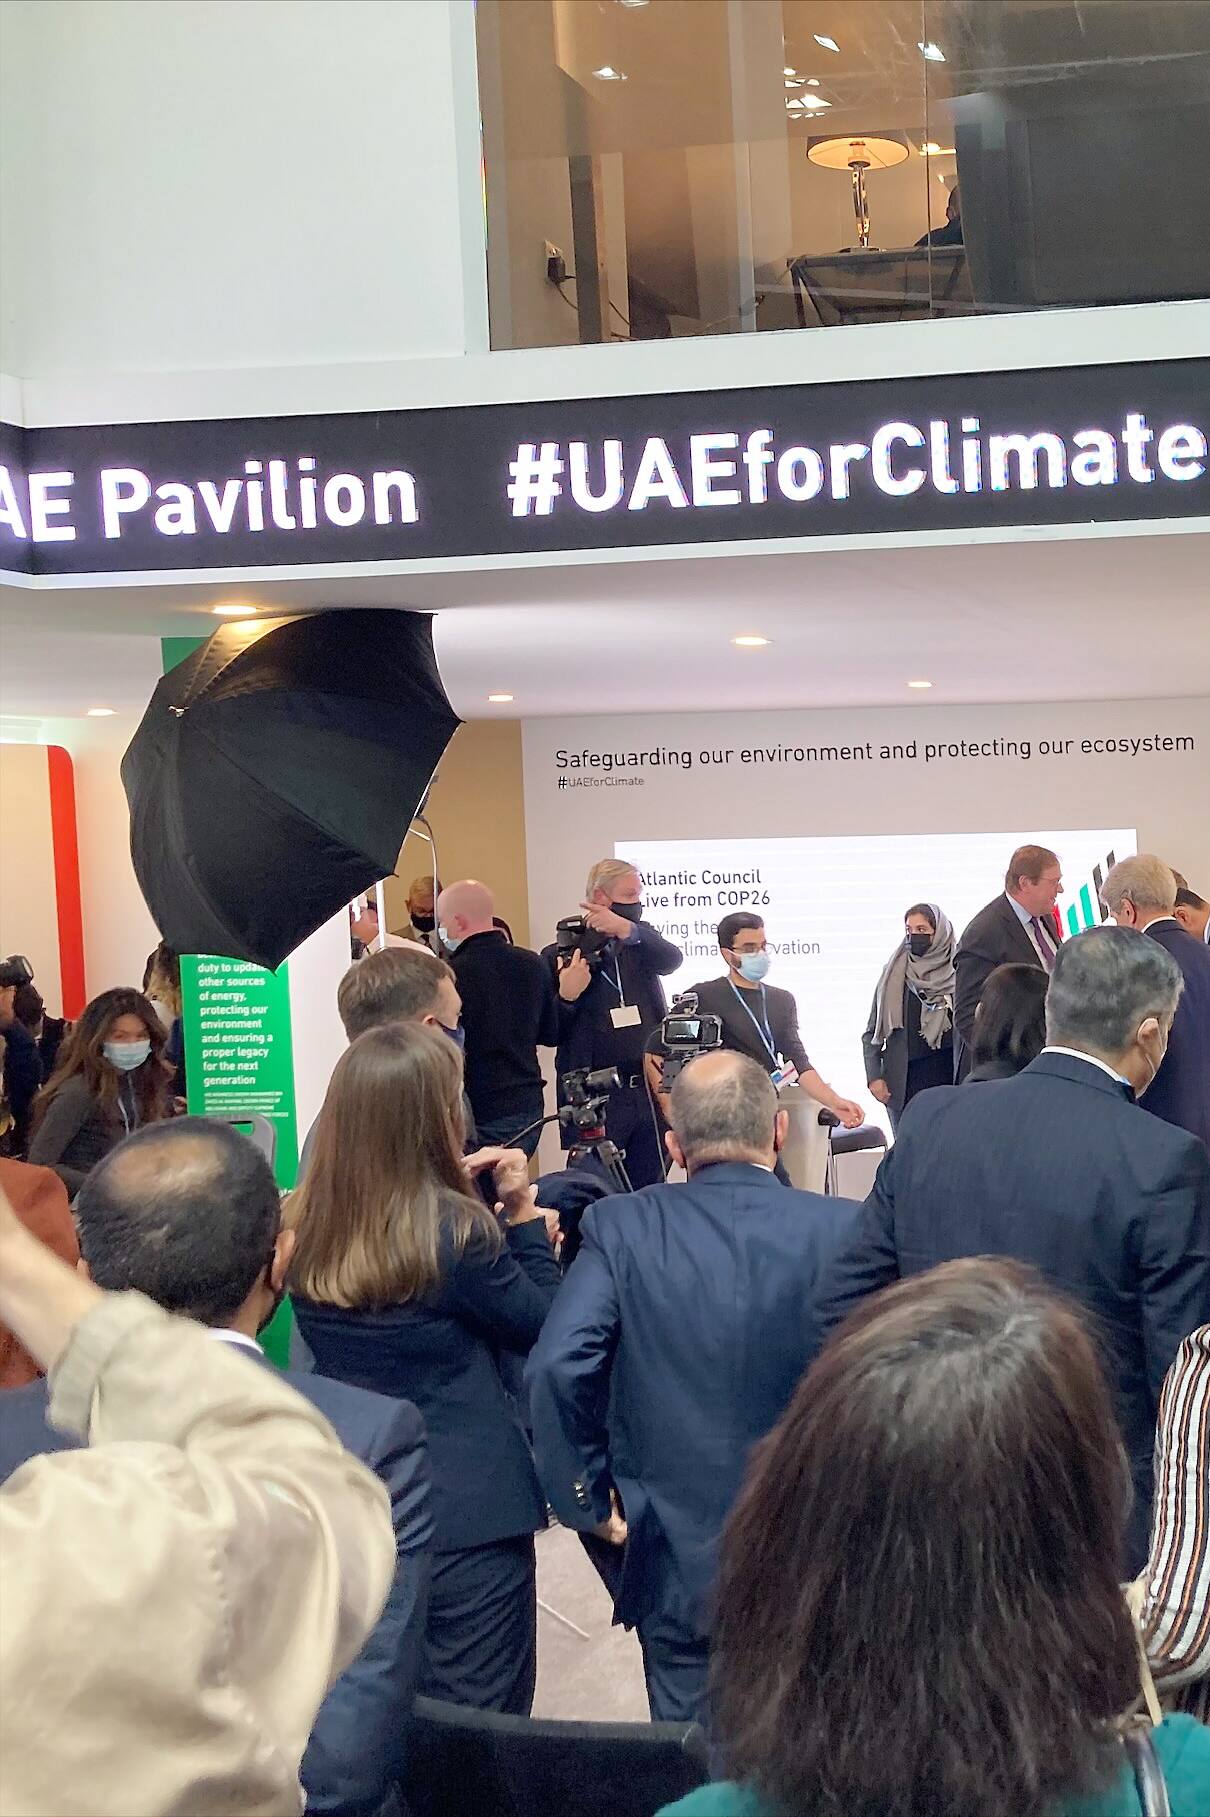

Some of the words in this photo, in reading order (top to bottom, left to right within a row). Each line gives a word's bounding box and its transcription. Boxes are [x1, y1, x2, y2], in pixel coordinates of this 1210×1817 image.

[100, 457, 420, 540] Pavilion
[507, 412, 1207, 517] #UAEforClimate
[556, 748, 692, 771] Safeguarding
[699, 750, 735, 765] our
[740, 743, 873, 763] environment
[879, 740, 917, 759] and
[925, 738, 1032, 763] protecting
[1038, 739, 1075, 755] our
[1080, 733, 1195, 757] ecosystem
[558, 775, 645, 790] #UAEforClimate
[640, 870, 697, 886] Atlantic
[701, 868, 762, 885] Council
[673, 891, 712, 907] from
[717, 889, 771, 906] COP26
[694, 919, 719, 935] the
[198, 963, 219, 974] duty
[221, 963, 231, 972] to
[198, 977, 224, 987] other
[226, 977, 266, 987] sources
[199, 991, 209, 1001] of
[200, 1005, 249, 1017] protecting
[251, 1006, 269, 1014] our
[200, 1019, 263, 1030] environment
[201, 1033, 220, 1043] and
[222, 1033, 265, 1044] ensuring
[266, 1034, 274, 1042] a
[202, 1048, 236, 1059] proper
[237, 1046, 270, 1059] legacy
[203, 1060, 218, 1071] for
[219, 1060, 236, 1071] the
[237, 1060, 259, 1071] next
[203, 1075, 256, 1087] generation
